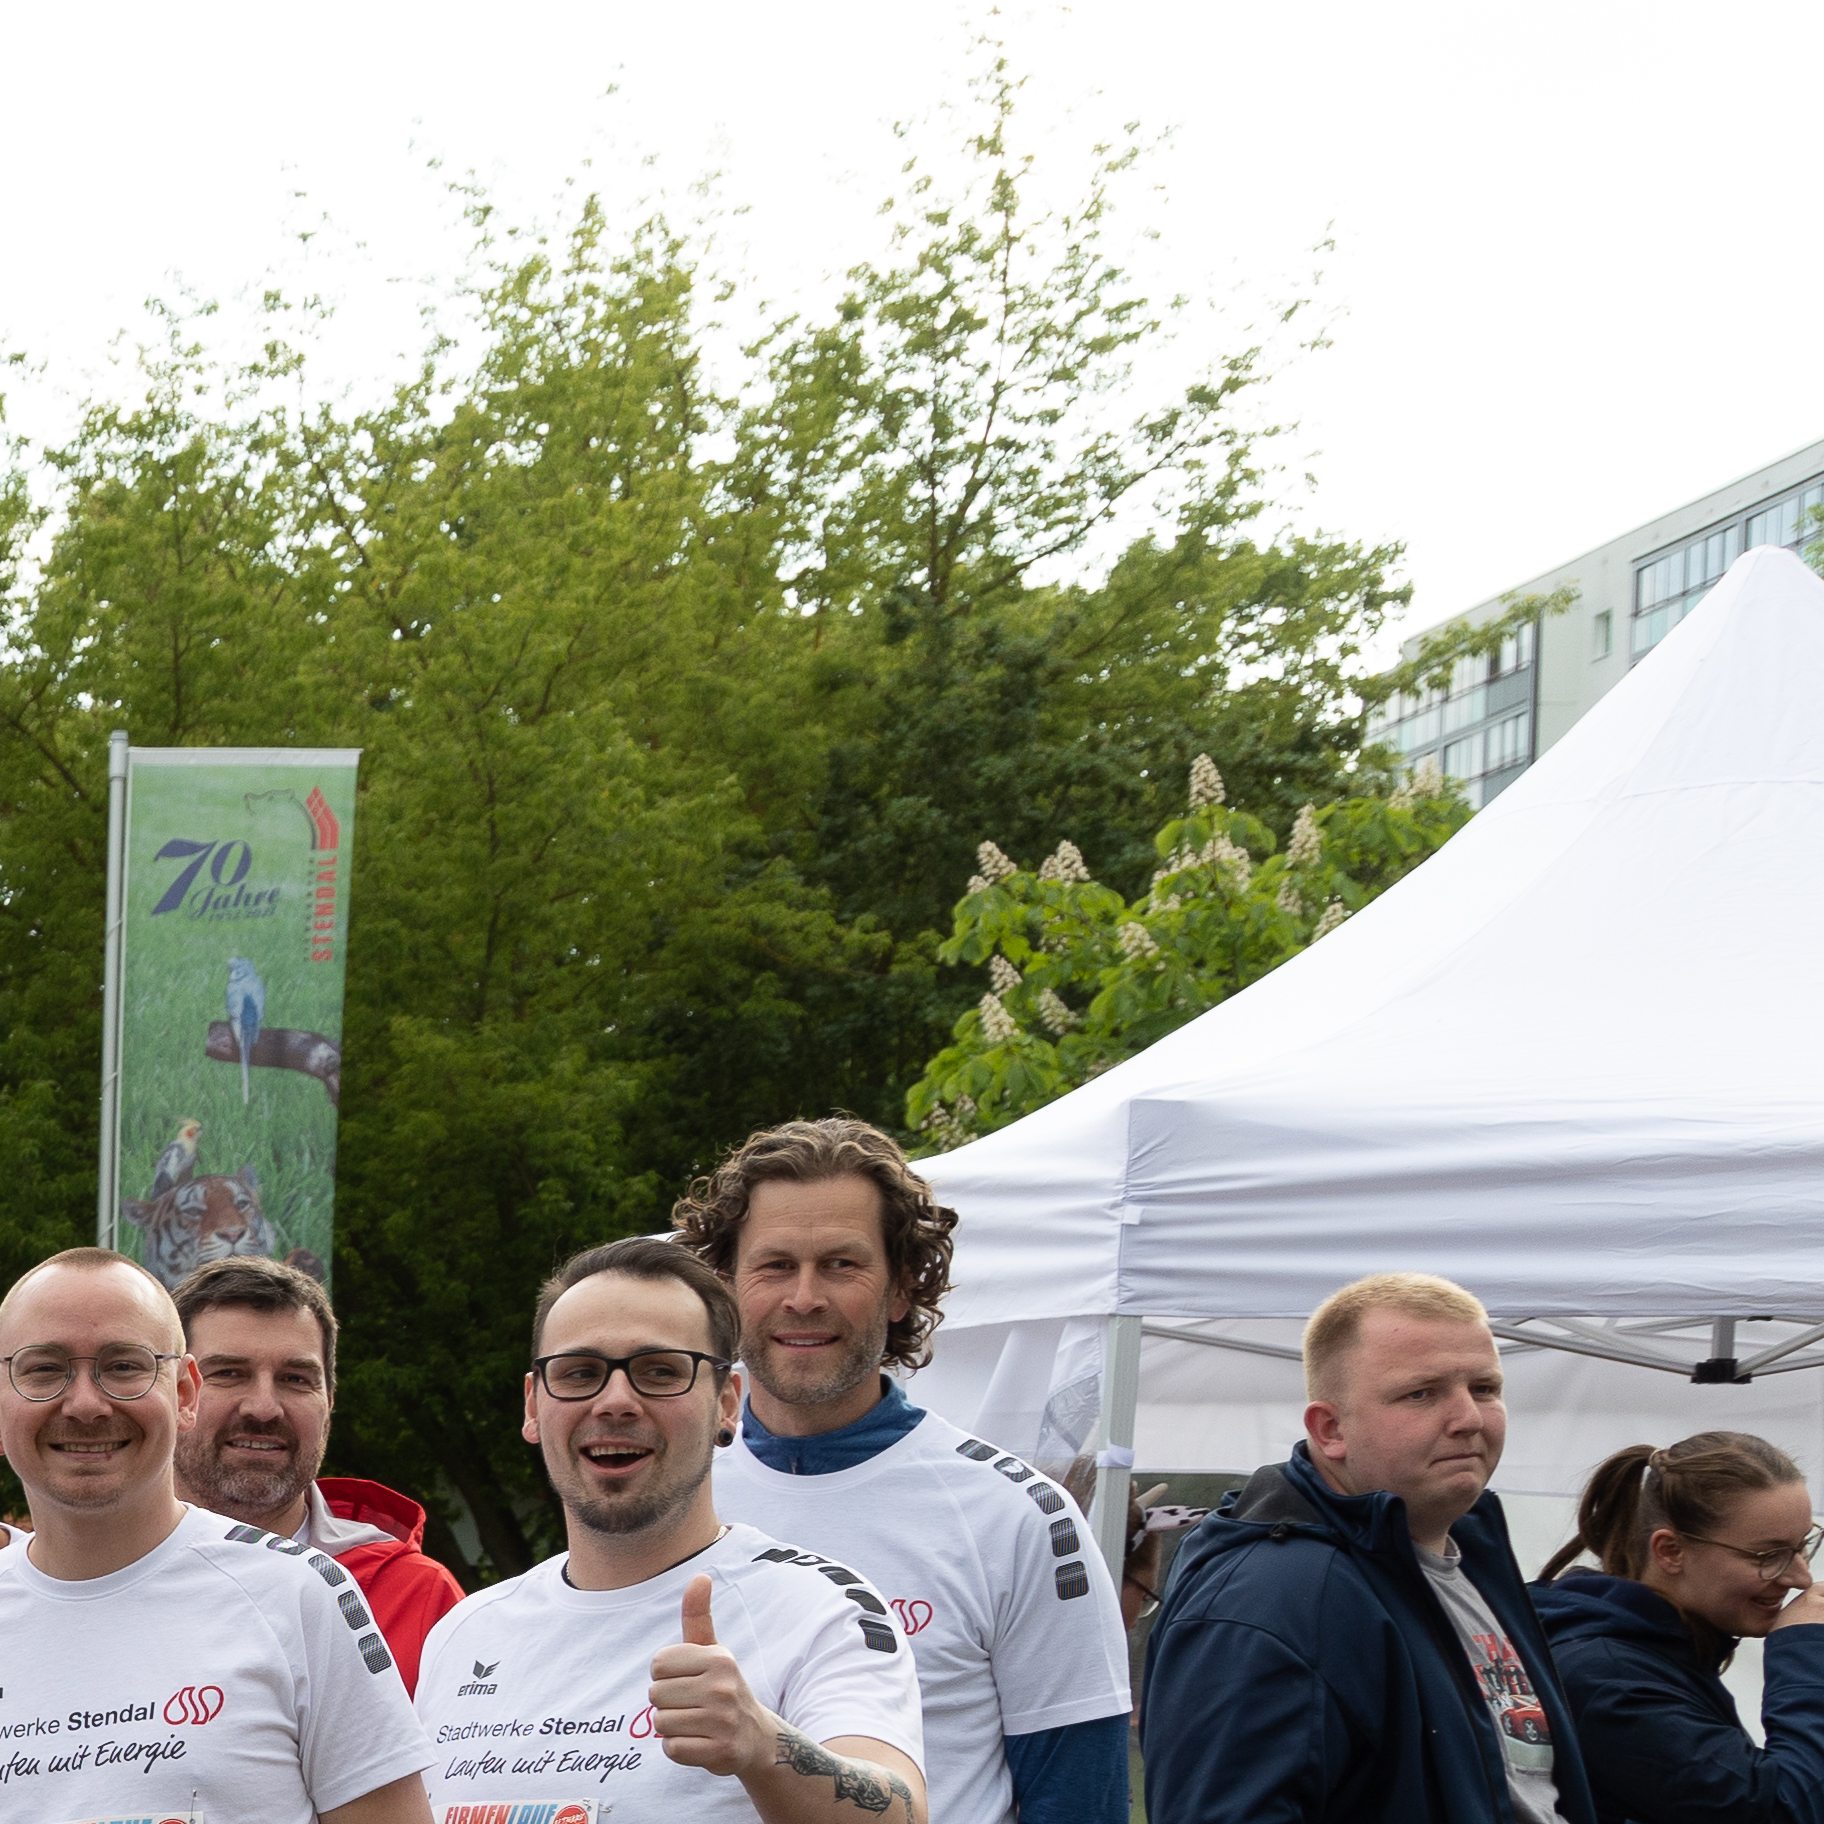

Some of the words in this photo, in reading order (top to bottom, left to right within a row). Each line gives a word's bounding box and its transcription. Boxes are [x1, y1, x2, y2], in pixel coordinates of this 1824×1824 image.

[151, 838, 253, 916] 70
[189, 883, 281, 922] Jahre
[311, 855, 338, 963] STENDAL
[456, 1680, 498, 1697] erima
[67, 1701, 156, 1732] Stendal
[436, 1718, 535, 1745] Stadtwerke
[539, 1714, 626, 1736] Stendal
[47, 1744, 92, 1773] mit
[93, 1733, 188, 1774] Energie
[444, 1749, 507, 1780] Laufen
[511, 1749, 556, 1775] mit
[556, 1746, 643, 1784] Energie
